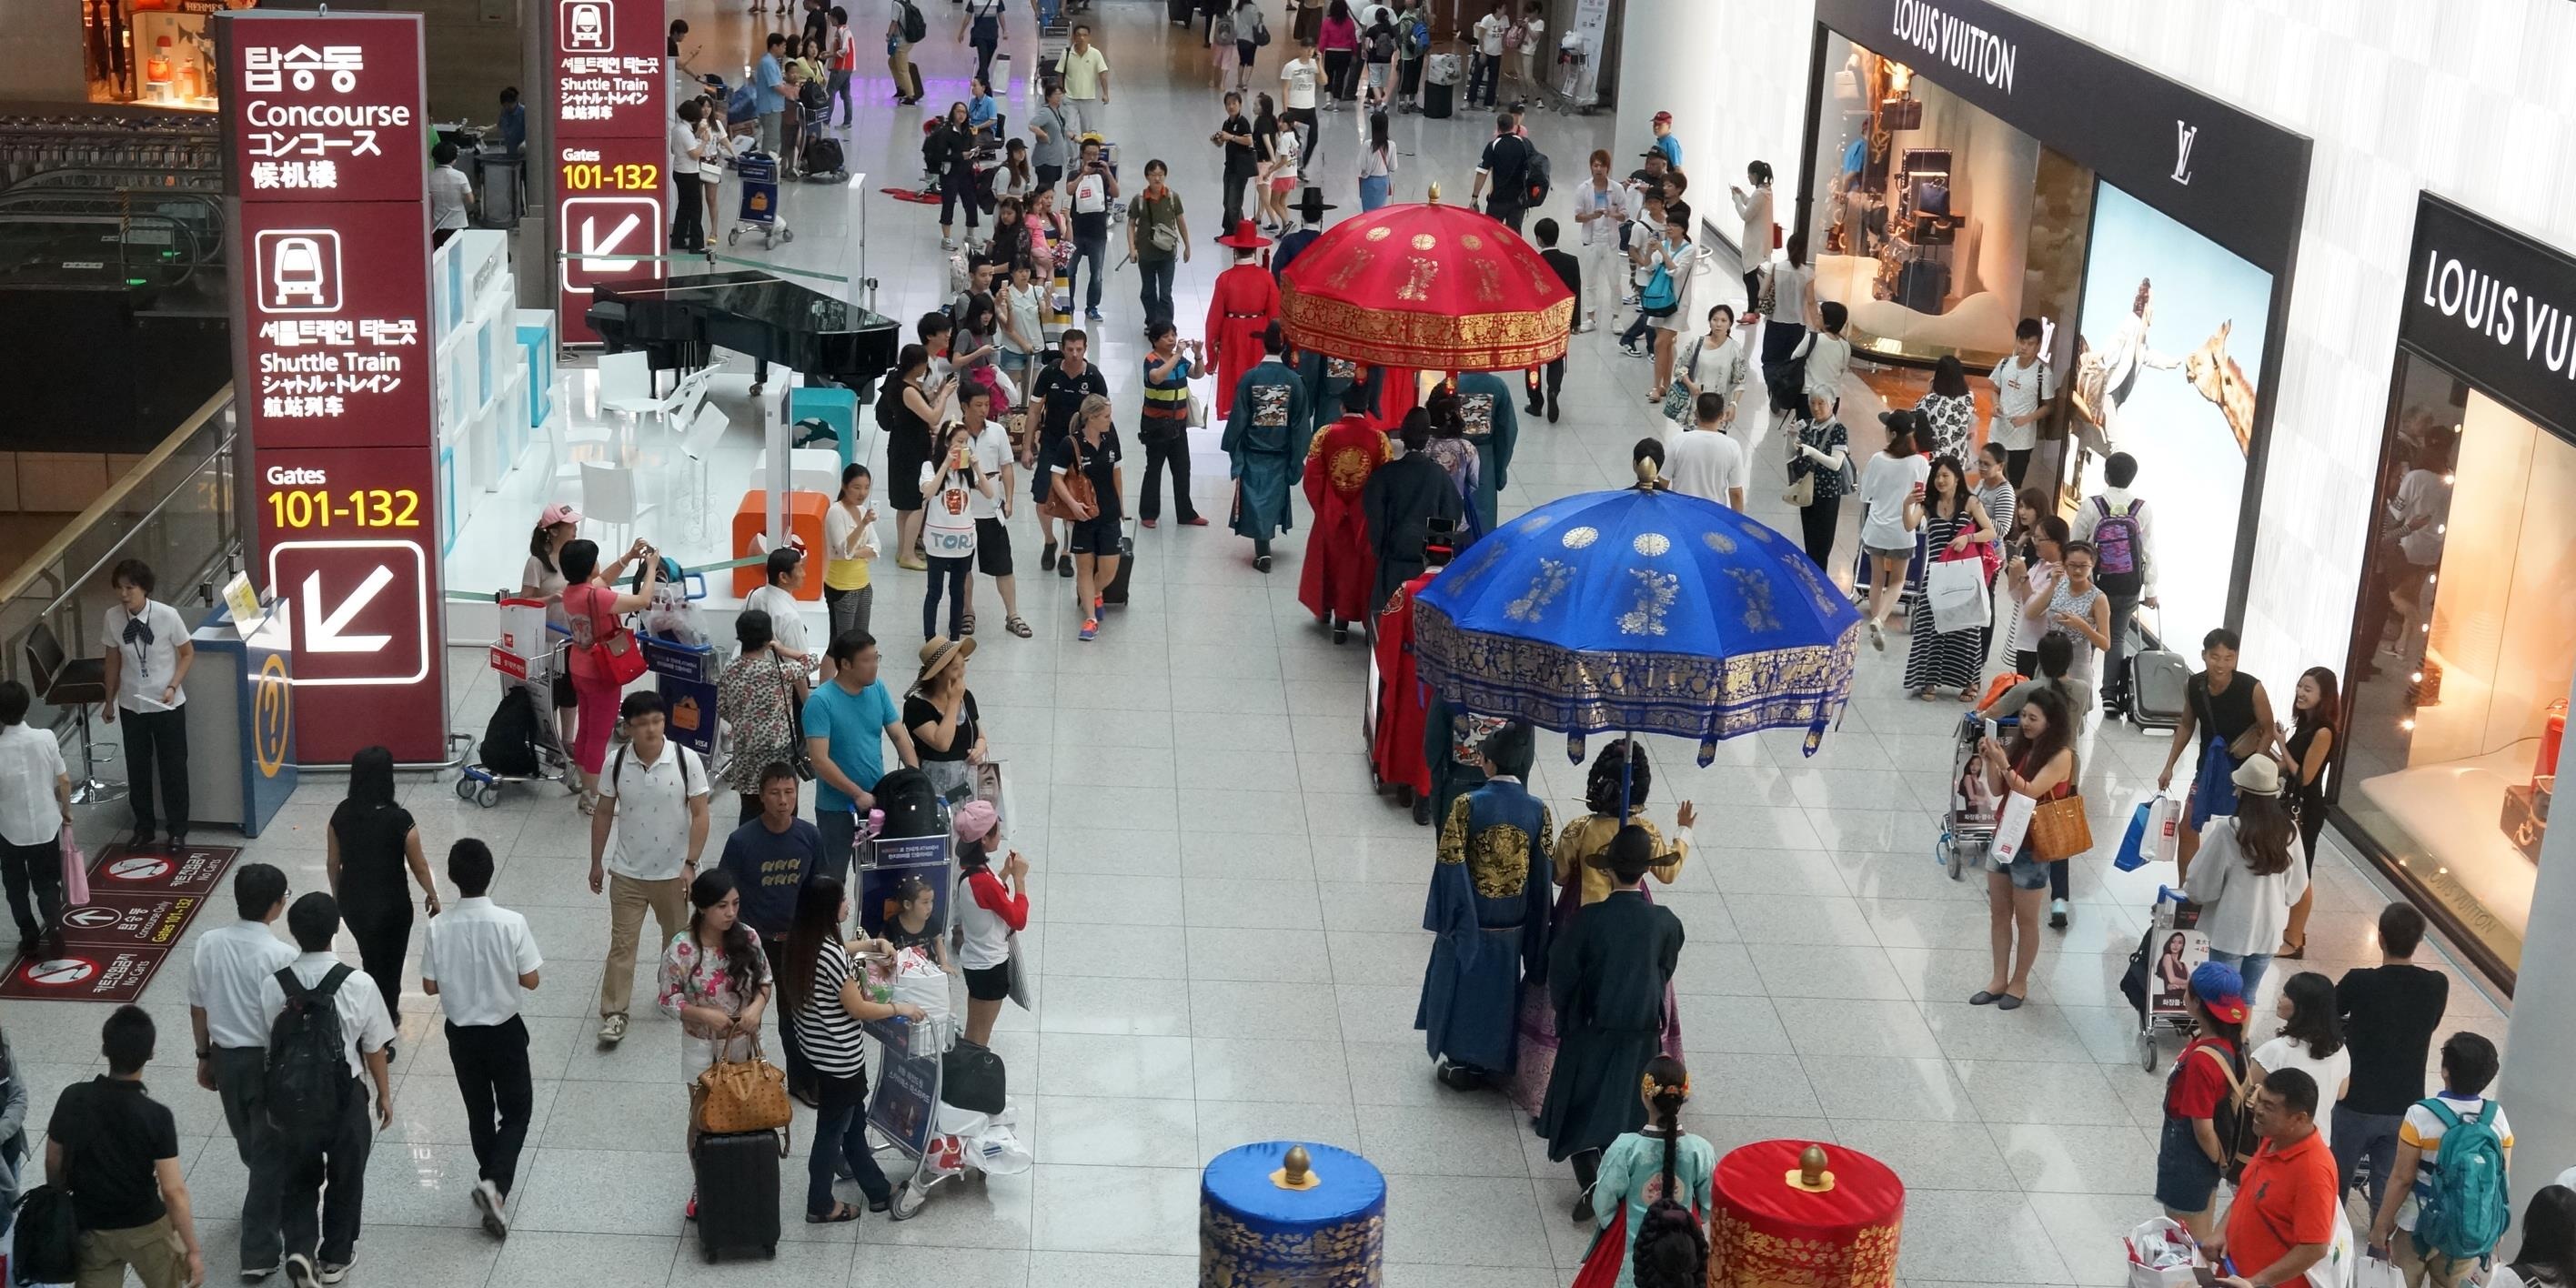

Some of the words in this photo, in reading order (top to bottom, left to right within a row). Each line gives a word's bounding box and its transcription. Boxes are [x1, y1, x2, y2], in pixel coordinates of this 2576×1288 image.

[1893, 0, 1939, 55] LOUIS
[1942, 12, 2017, 96] VUITTON
[245, 44, 364, 93] 탑승동
[561, 57, 620, 74] 셔틀트레인
[623, 57, 659, 74] 타는곳
[561, 77, 610, 91] Shuttle
[613, 78, 649, 90] Train
[247, 100, 410, 126] Concourse
[247, 130, 382, 158] コンコース
[562, 148, 600, 161] Gates
[563, 165, 659, 190] 101-132
[2424, 250, 2518, 346] LOUIS
[259, 320, 355, 347] 셔틀트레인
[359, 319, 418, 346] 타는곳
[260, 352, 339, 373] Shuttle
[343, 352, 400, 371] Train
[263, 396, 344, 418] 航站列车
[267, 466, 327, 485] Gates
[268, 489, 419, 528] 101-132
[694, 739, 708, 748] VISA
[203, 860, 222, 872] Carts
[117, 908, 149, 931] 탑승동
[135, 912, 162, 938] Concourse
[153, 901, 173, 912] Only
[152, 924, 176, 942] Gates
[129, 961, 150, 976] Carts
[122, 977, 138, 986] No
